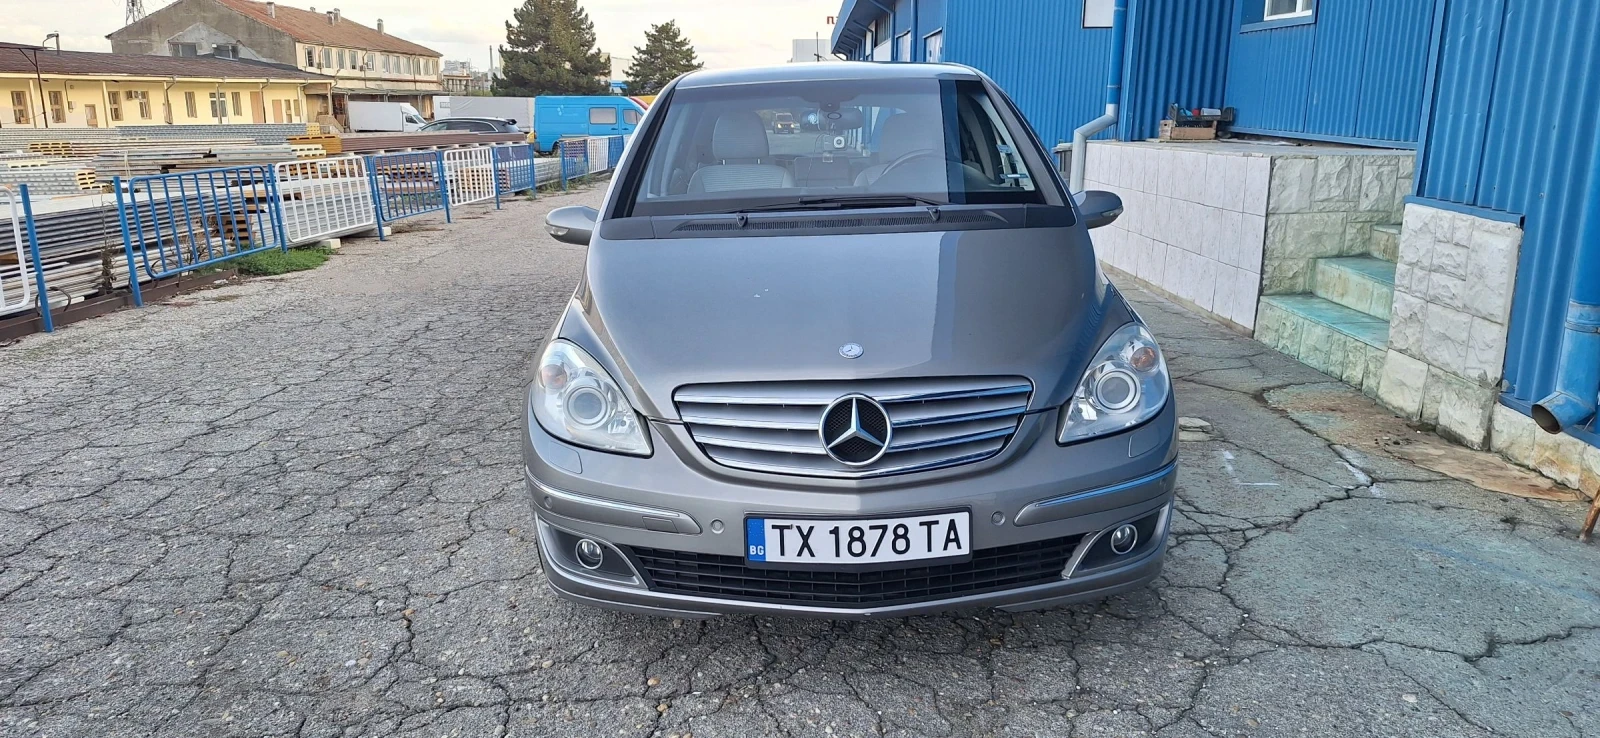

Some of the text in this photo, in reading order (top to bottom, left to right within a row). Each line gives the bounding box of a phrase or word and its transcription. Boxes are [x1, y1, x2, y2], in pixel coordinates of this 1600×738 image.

[749, 544, 765, 556] BG
[771, 518, 962, 558] TX 1878 TA
